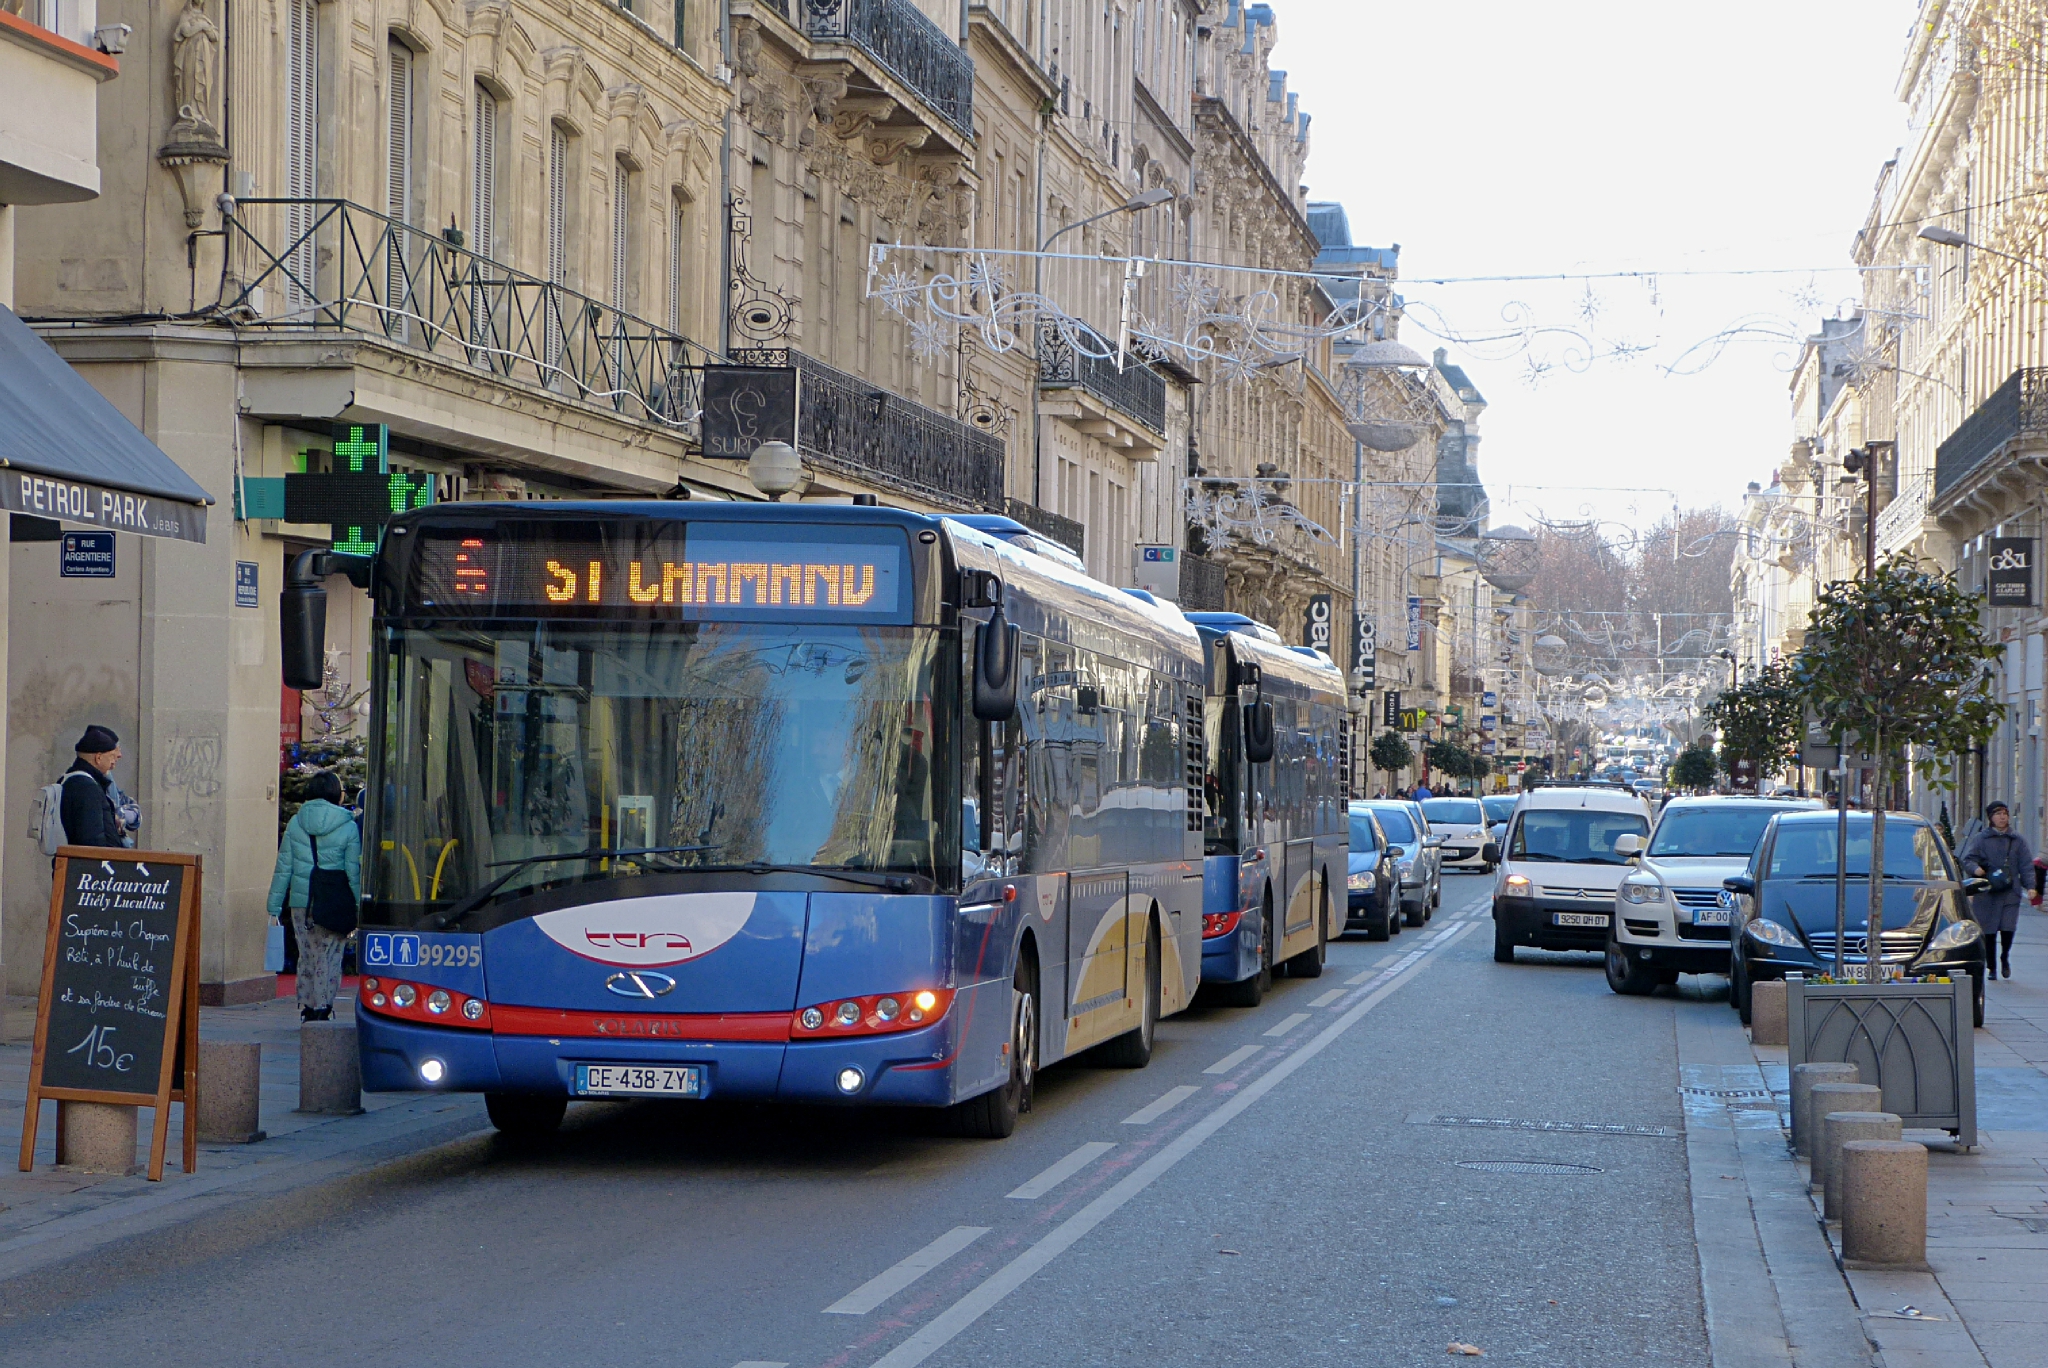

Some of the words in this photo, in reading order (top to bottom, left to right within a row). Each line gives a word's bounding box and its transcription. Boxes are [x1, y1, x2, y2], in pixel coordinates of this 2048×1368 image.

[21, 475, 95, 518] PETROL
[101, 490, 149, 529] PARK
[152, 515, 180, 533] Jeans
[81, 539, 95, 548] RUE
[65, 551, 112, 562] ARGENTIERE
[1145, 549, 1172, 560] CIC
[77, 873, 170, 895] Restaurant
[78, 892, 111, 911] Hiély
[113, 894, 166, 910] Lucullus
[111, 920, 123, 938] de
[419, 943, 481, 967] 99295
[141, 959, 156, 974] de
[61, 986, 74, 1002] et
[592, 1018, 683, 1036] SOLARIS
[67, 1024, 134, 1072] 15€
[588, 1068, 687, 1091] CE-438-ZY
